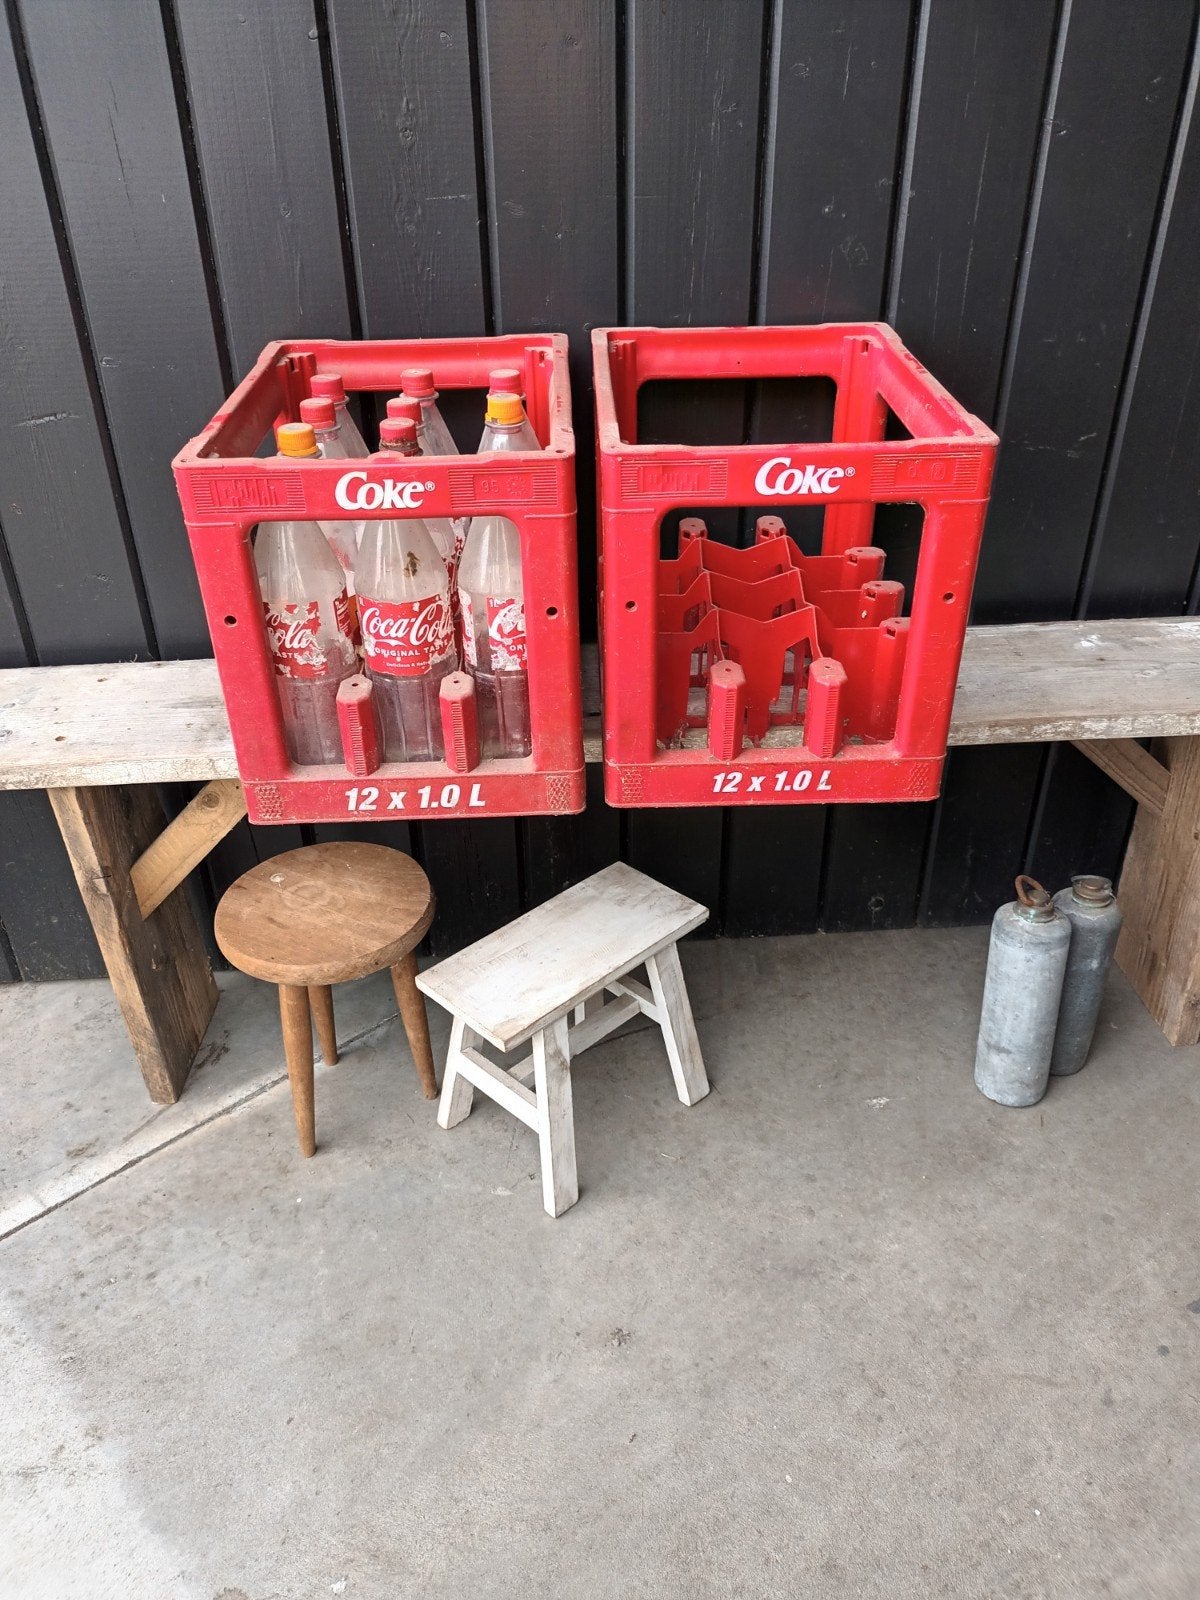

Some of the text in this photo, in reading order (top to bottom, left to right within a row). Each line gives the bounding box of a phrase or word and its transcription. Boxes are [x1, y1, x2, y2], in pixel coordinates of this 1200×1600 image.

[374, 647, 420, 657] ORIGINAL
[712, 769, 832, 794] 12 x 1.0 L
[345, 783, 486, 811] 12 x 1.0 L
